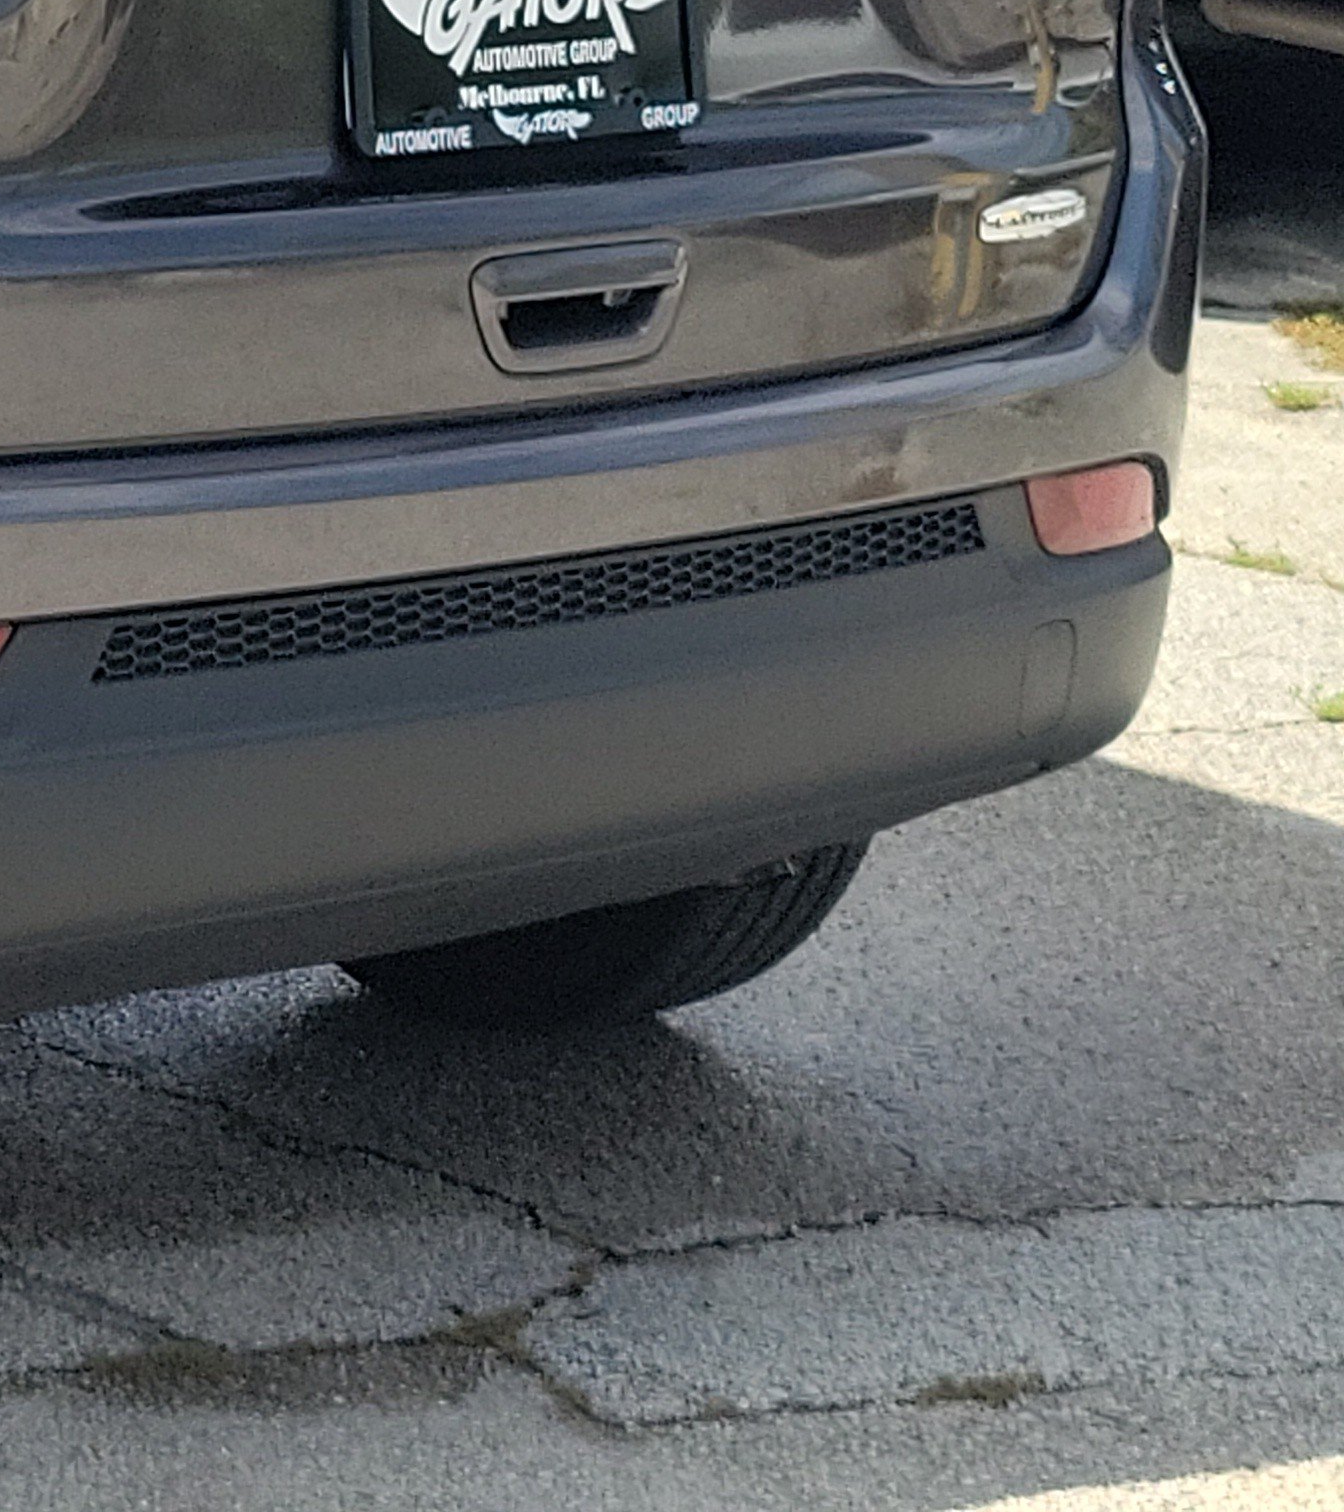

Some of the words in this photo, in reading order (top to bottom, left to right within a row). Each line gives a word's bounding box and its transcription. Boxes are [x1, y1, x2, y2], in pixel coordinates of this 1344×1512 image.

[473, 42, 567, 72] AUTOMOTIVE
[570, 38, 618, 65] GROUP
[578, 75, 606, 100] FL
[376, 126, 472, 155] AUTOMOTIVE
[515, 110, 578, 145] GATOR
[641, 103, 699, 129] GROUP
